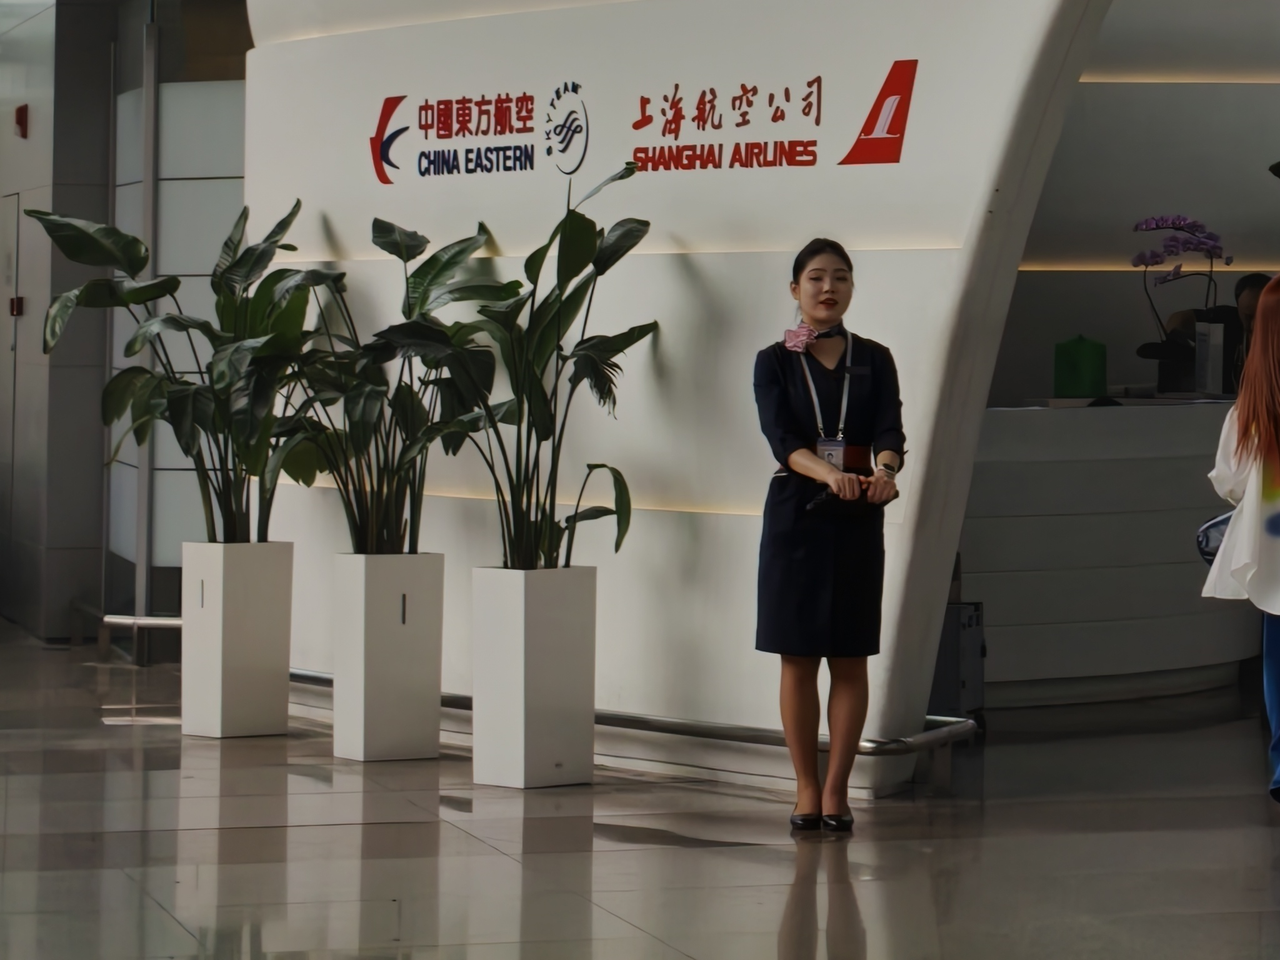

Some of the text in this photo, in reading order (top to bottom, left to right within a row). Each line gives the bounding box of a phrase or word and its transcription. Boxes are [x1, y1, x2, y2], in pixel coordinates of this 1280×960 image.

[418, 91, 535, 140] 中國東方航空
[632, 75, 822, 141] 上海航空公司
[418, 143, 535, 177] CHINA EASTERN
[633, 140, 818, 172] SHANGHAI AIRLINES
